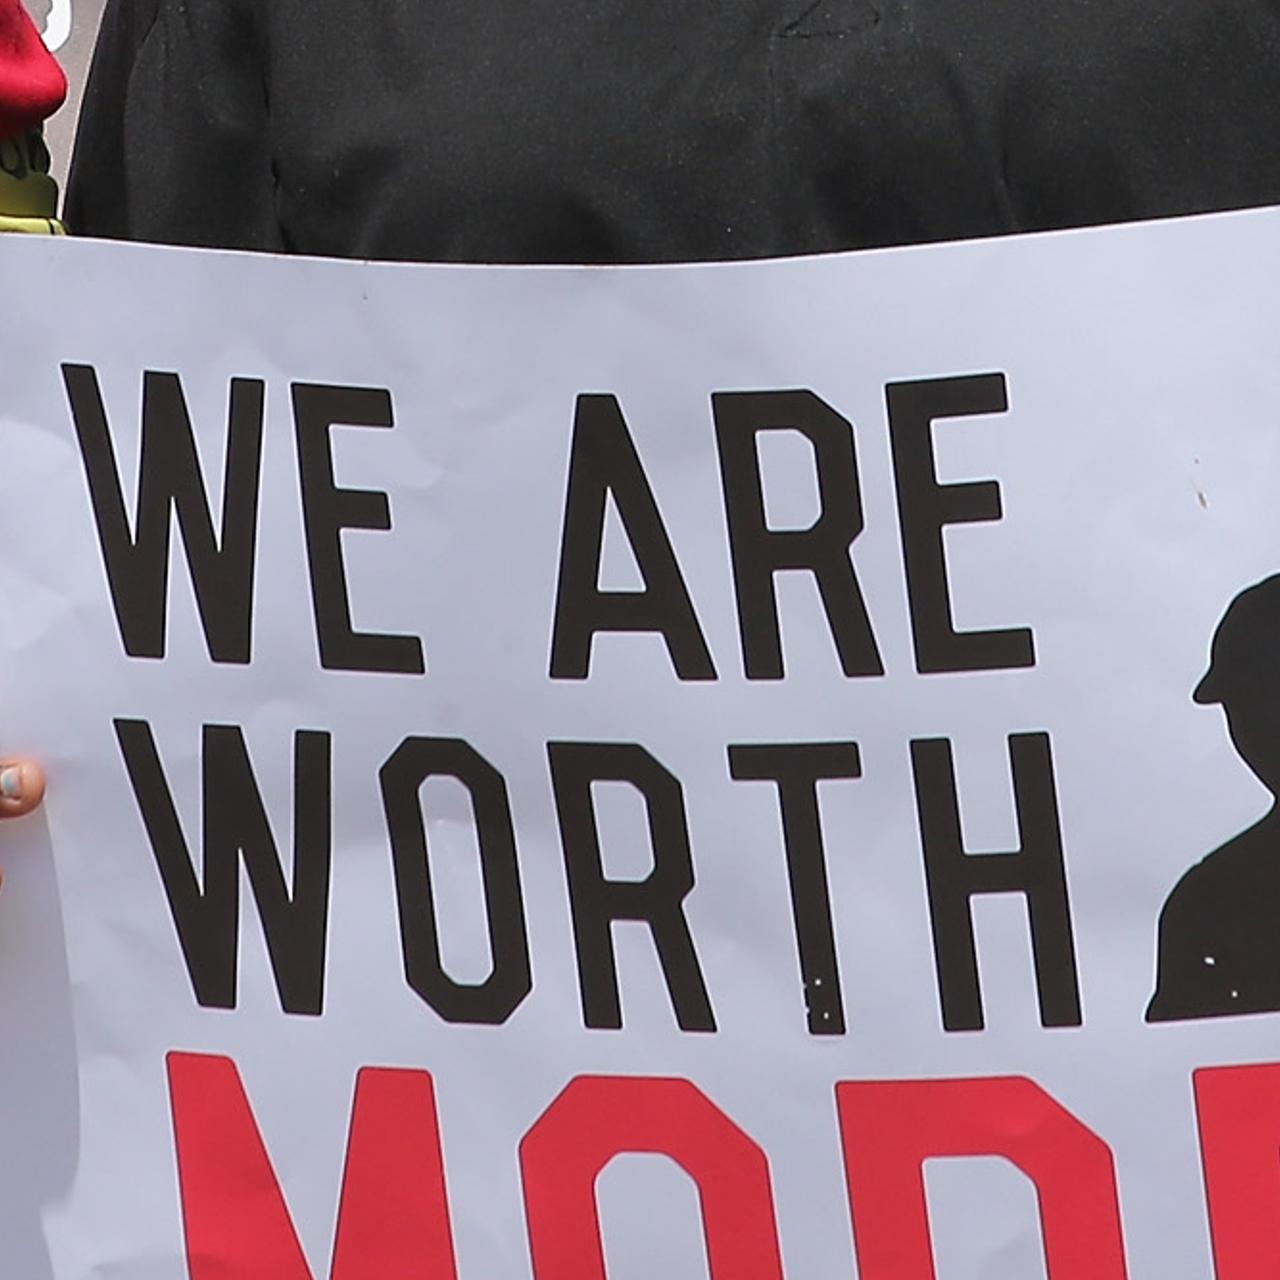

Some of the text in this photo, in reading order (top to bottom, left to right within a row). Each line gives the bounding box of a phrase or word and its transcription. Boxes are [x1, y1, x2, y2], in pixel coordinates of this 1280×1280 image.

[61, 362, 1037, 682] WE ARE
[112, 716, 1084, 1037] WORTH
